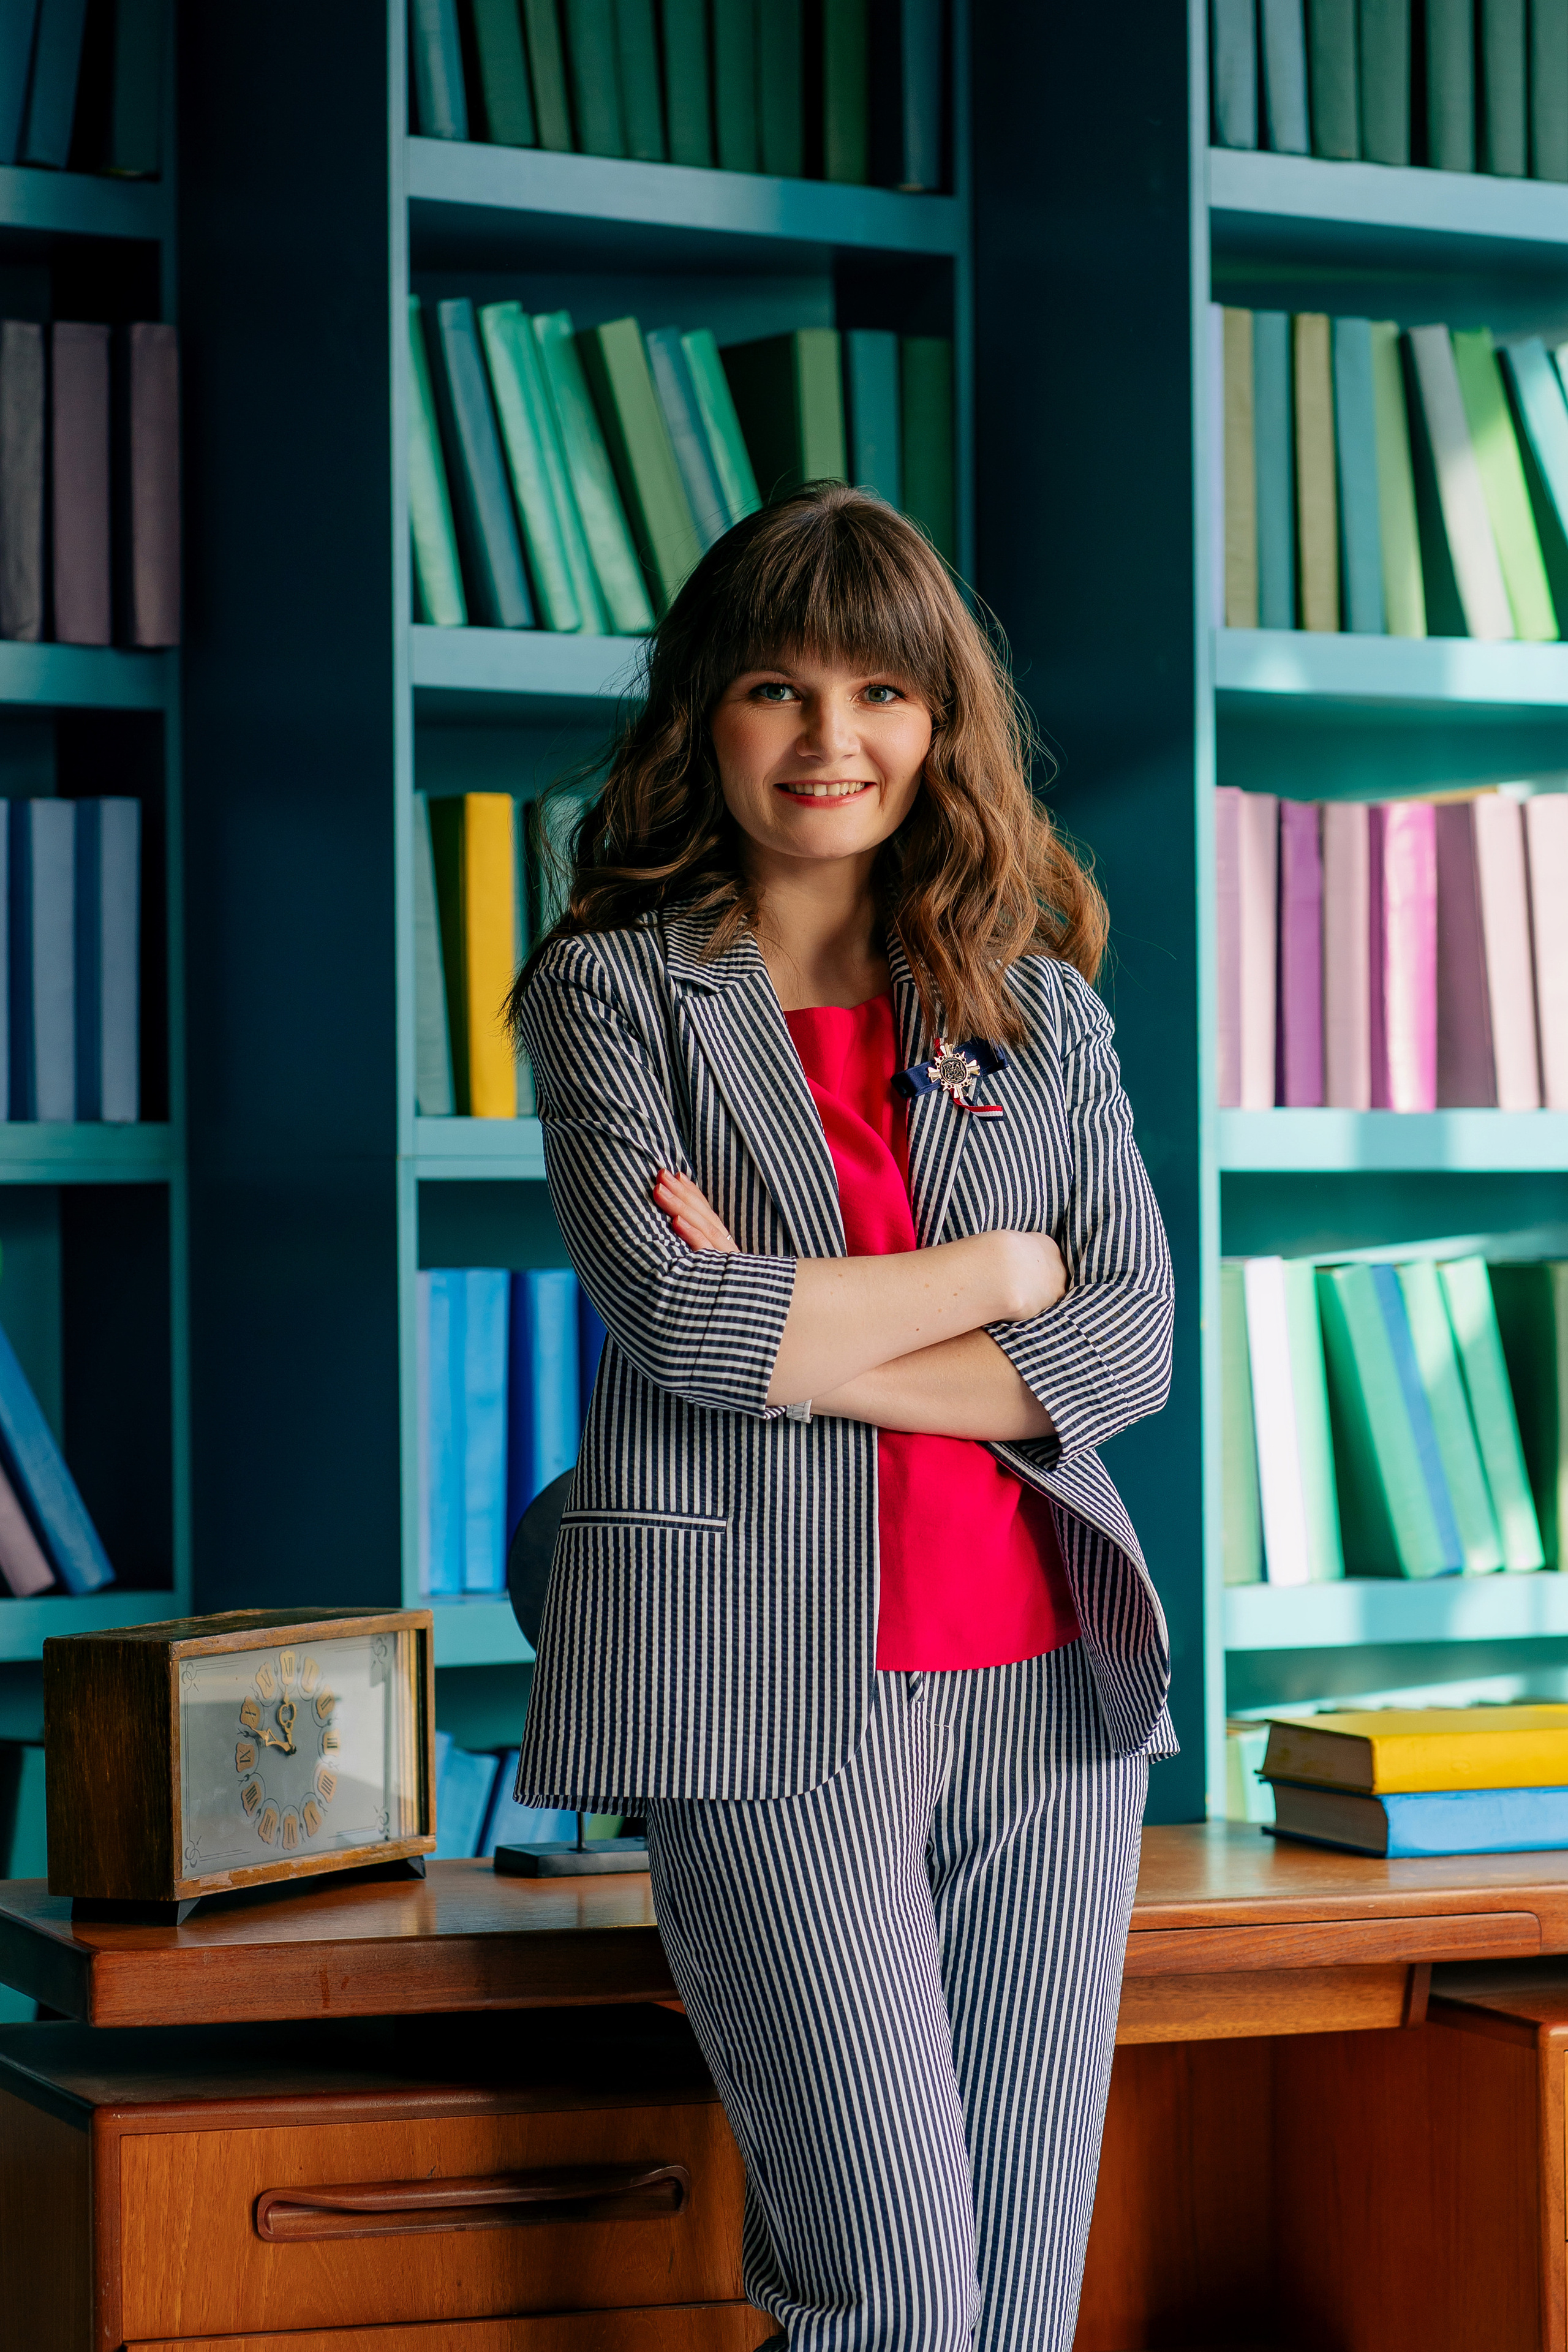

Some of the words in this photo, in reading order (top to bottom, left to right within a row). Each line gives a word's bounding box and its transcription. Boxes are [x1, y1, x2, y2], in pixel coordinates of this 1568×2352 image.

[283, 1657, 293, 1677] XII
[320, 1695, 332, 1710] II
[245, 1705, 257, 1722] X
[327, 1738, 338, 1748] III
[239, 1750, 251, 1763] IX
[321, 1774, 334, 1795] IIII
[245, 1785, 258, 1811] VIII
[263, 1814, 274, 1839] VII
[309, 1810, 317, 1830] V
[287, 1822, 295, 1844] VI
